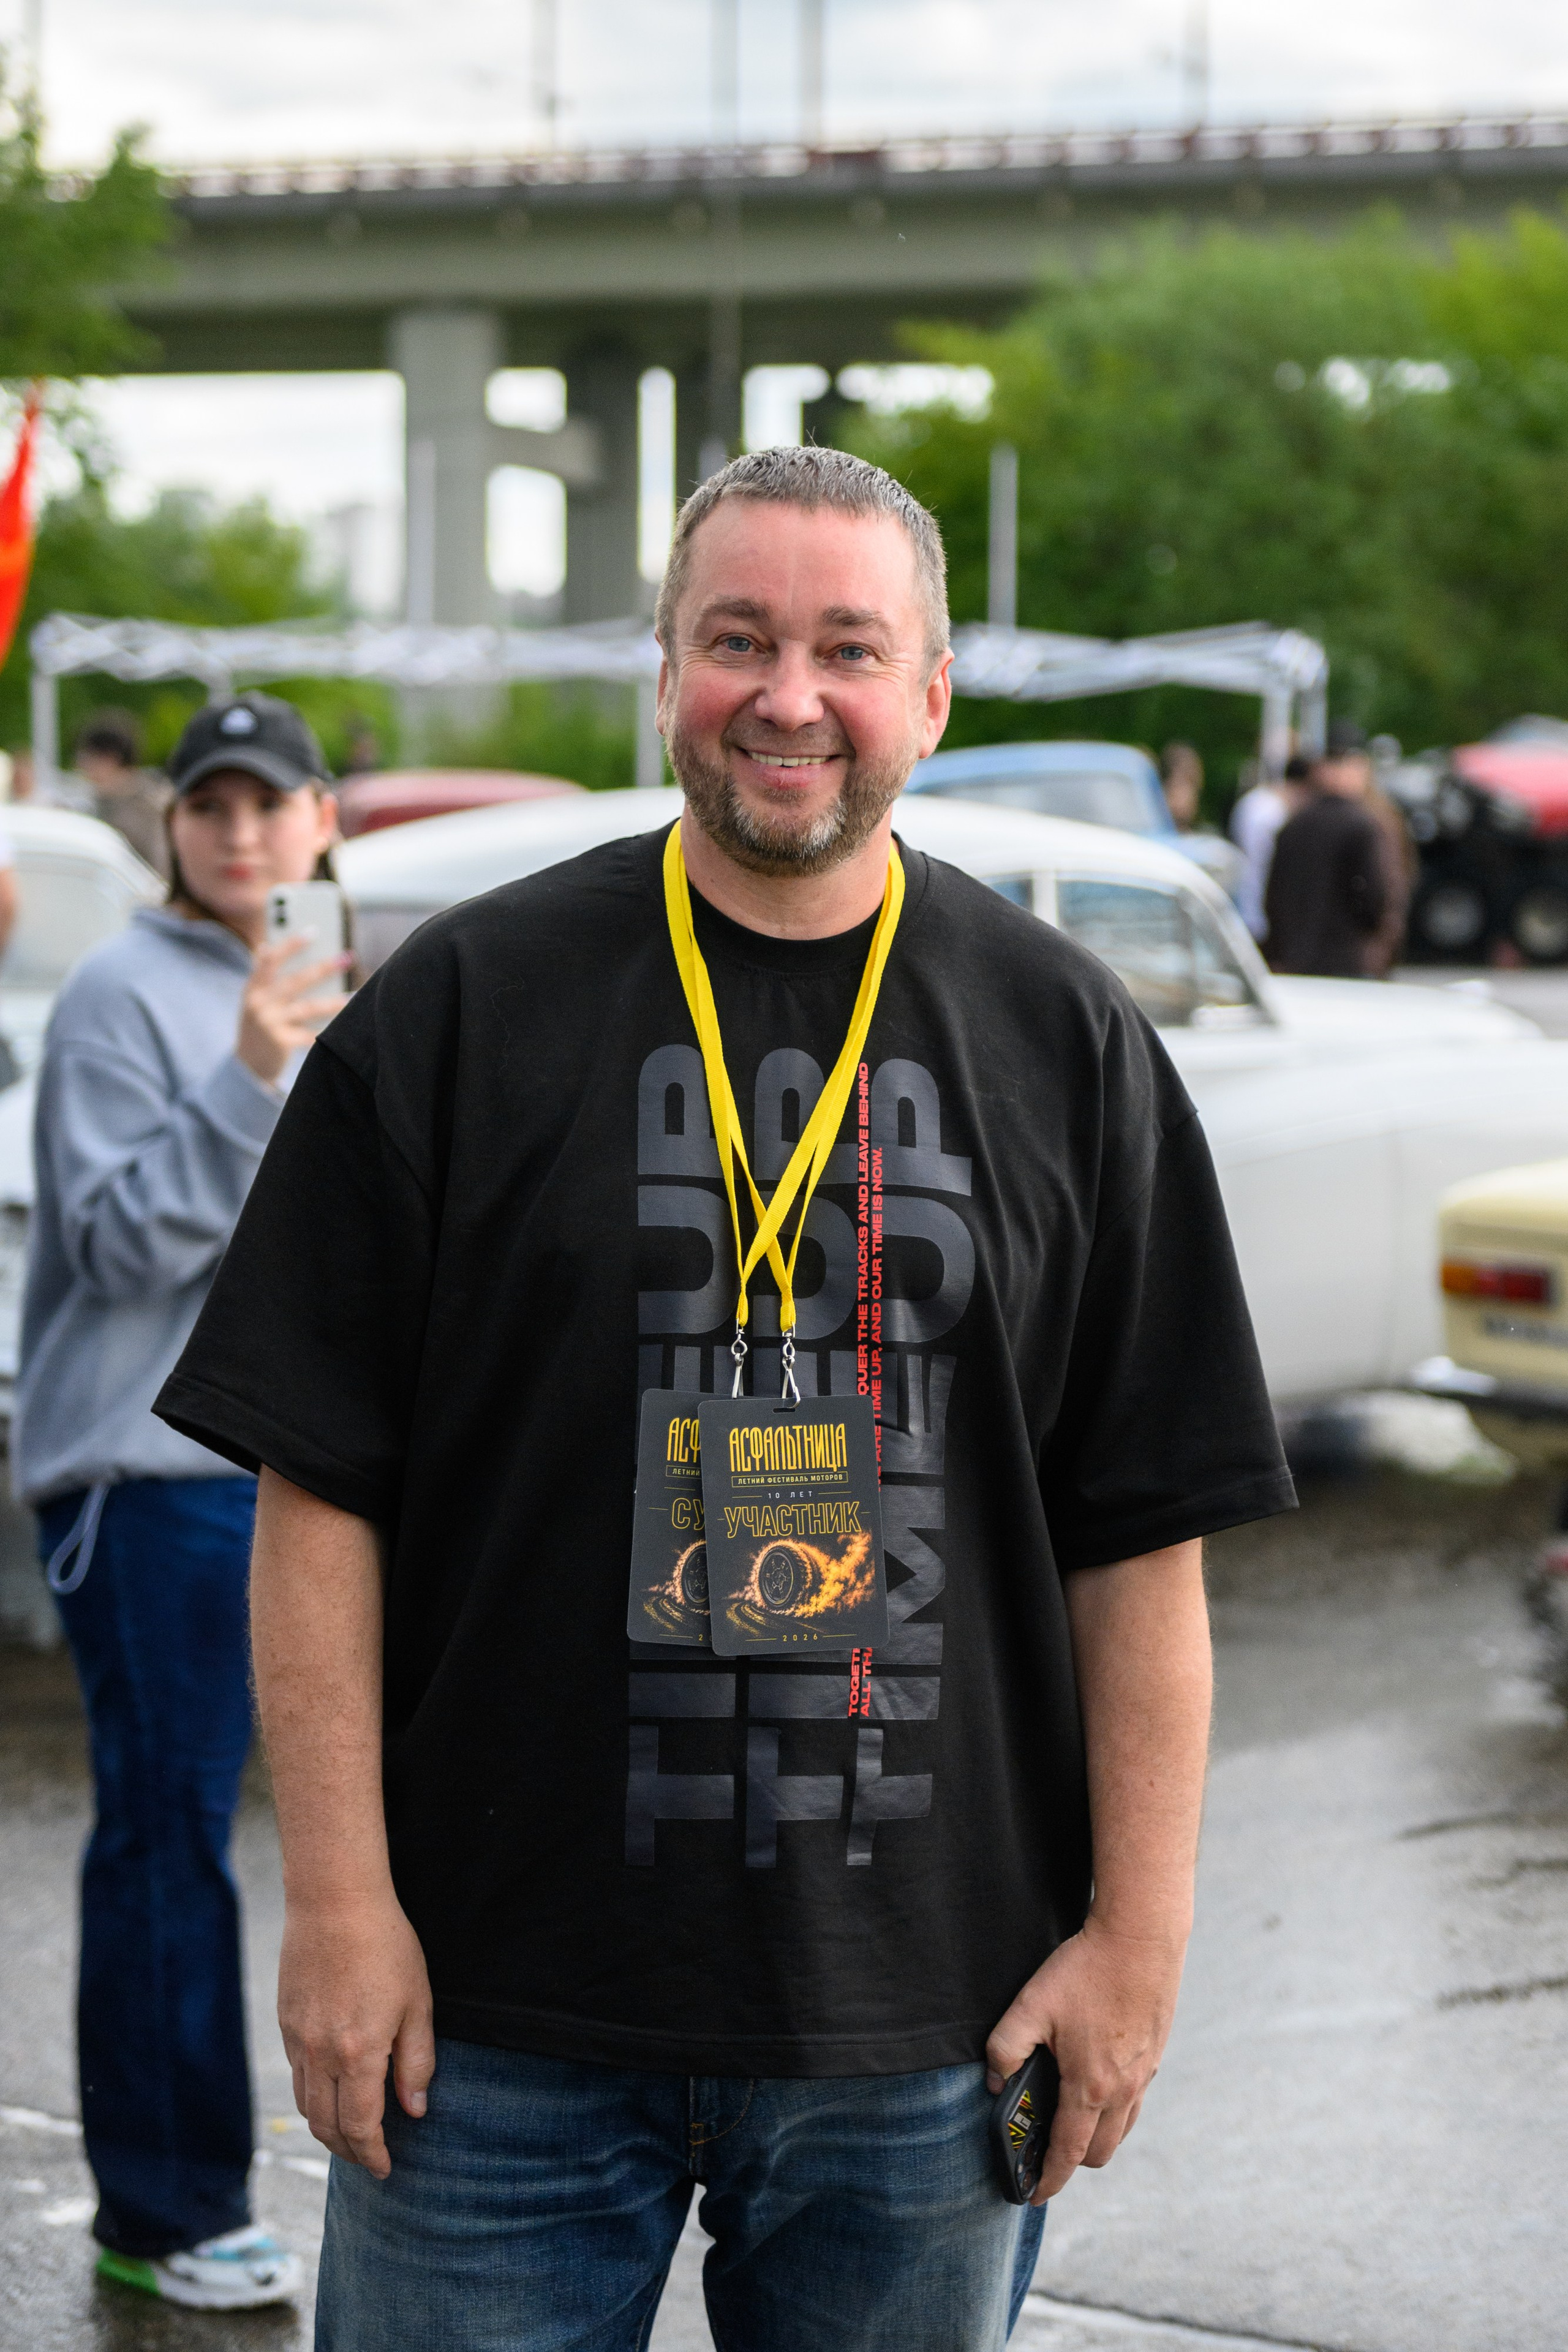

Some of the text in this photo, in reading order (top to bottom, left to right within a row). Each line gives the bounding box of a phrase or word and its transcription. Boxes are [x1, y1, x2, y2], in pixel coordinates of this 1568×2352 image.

[872, 1147, 883, 1192] NOW.
[872, 1194, 883, 1211] IS
[872, 1213, 883, 1256] TIME
[872, 1258, 883, 1300] OUR
[872, 1302, 882, 1344] AND
[871, 1347, 883, 1377] UP,
[848, 1062, 870, 1717] TOGET QUER THE TRACKS AND LEAVE BEHIND
[729, 1423, 847, 1472] АСФАЛЬТНИЦА
[724, 1501, 862, 1538] УЧАСТНИК
[861, 1681, 871, 1717] ALL
